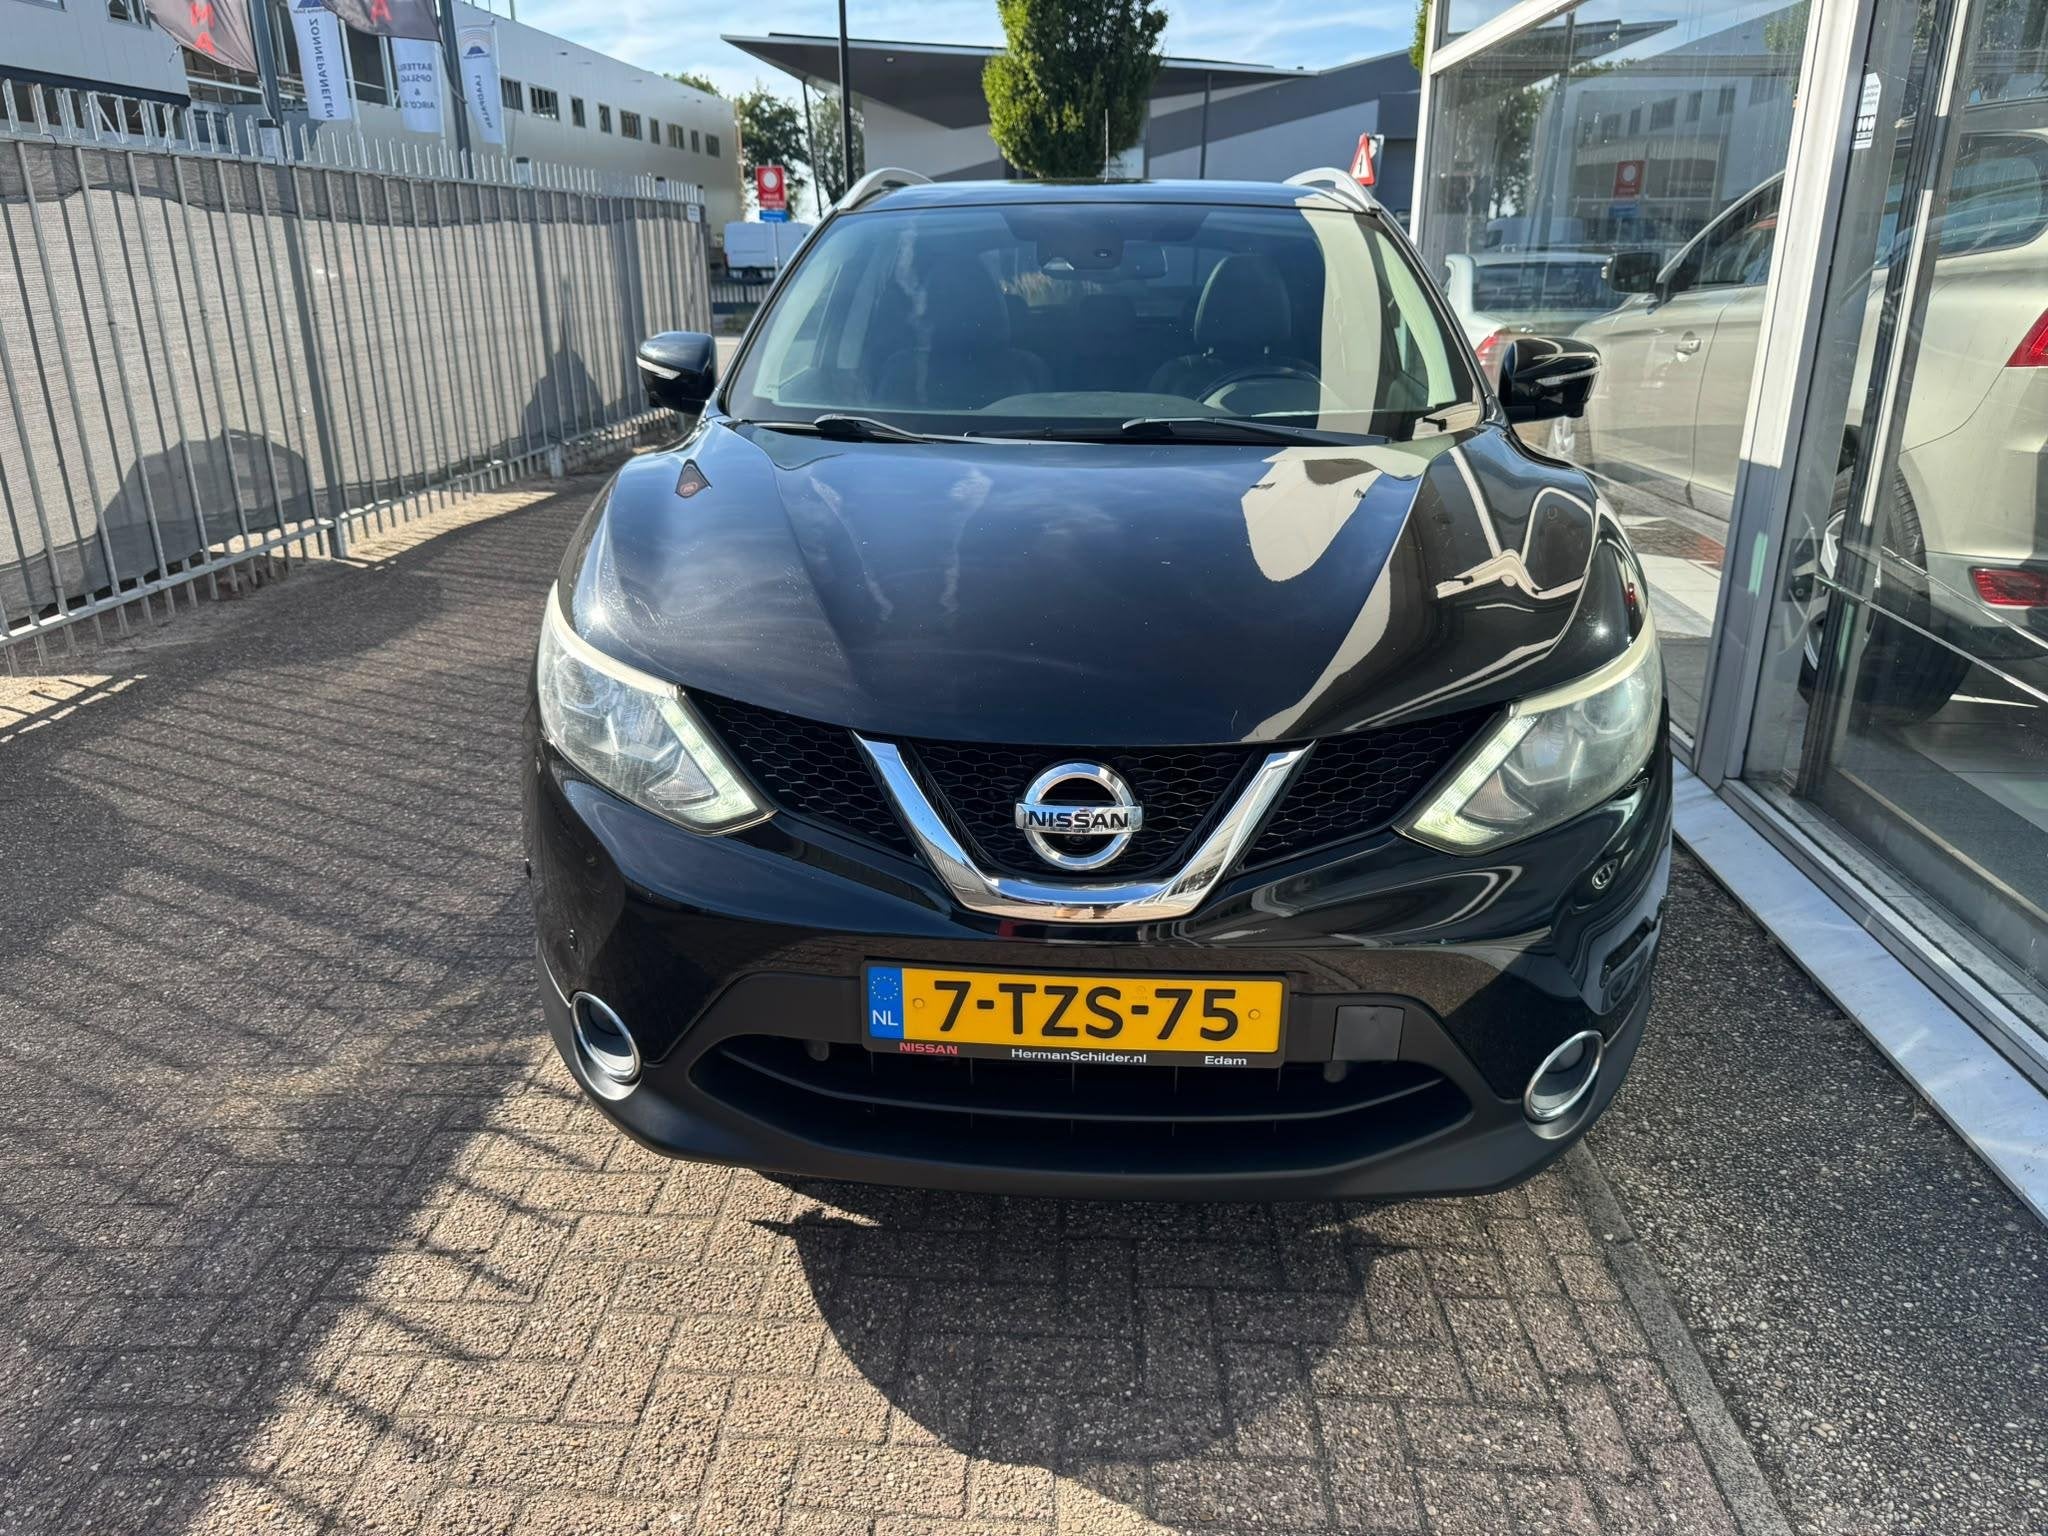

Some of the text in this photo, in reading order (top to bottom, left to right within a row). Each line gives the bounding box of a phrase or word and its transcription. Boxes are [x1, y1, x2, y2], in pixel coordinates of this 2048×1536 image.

[1028, 810, 1129, 829] NISSAN
[872, 1010, 899, 1026] NL
[934, 980, 1238, 1041] 7-TZS-75
[899, 1042, 1247, 1066] NISSAN HermanSchilder.nl Edam
